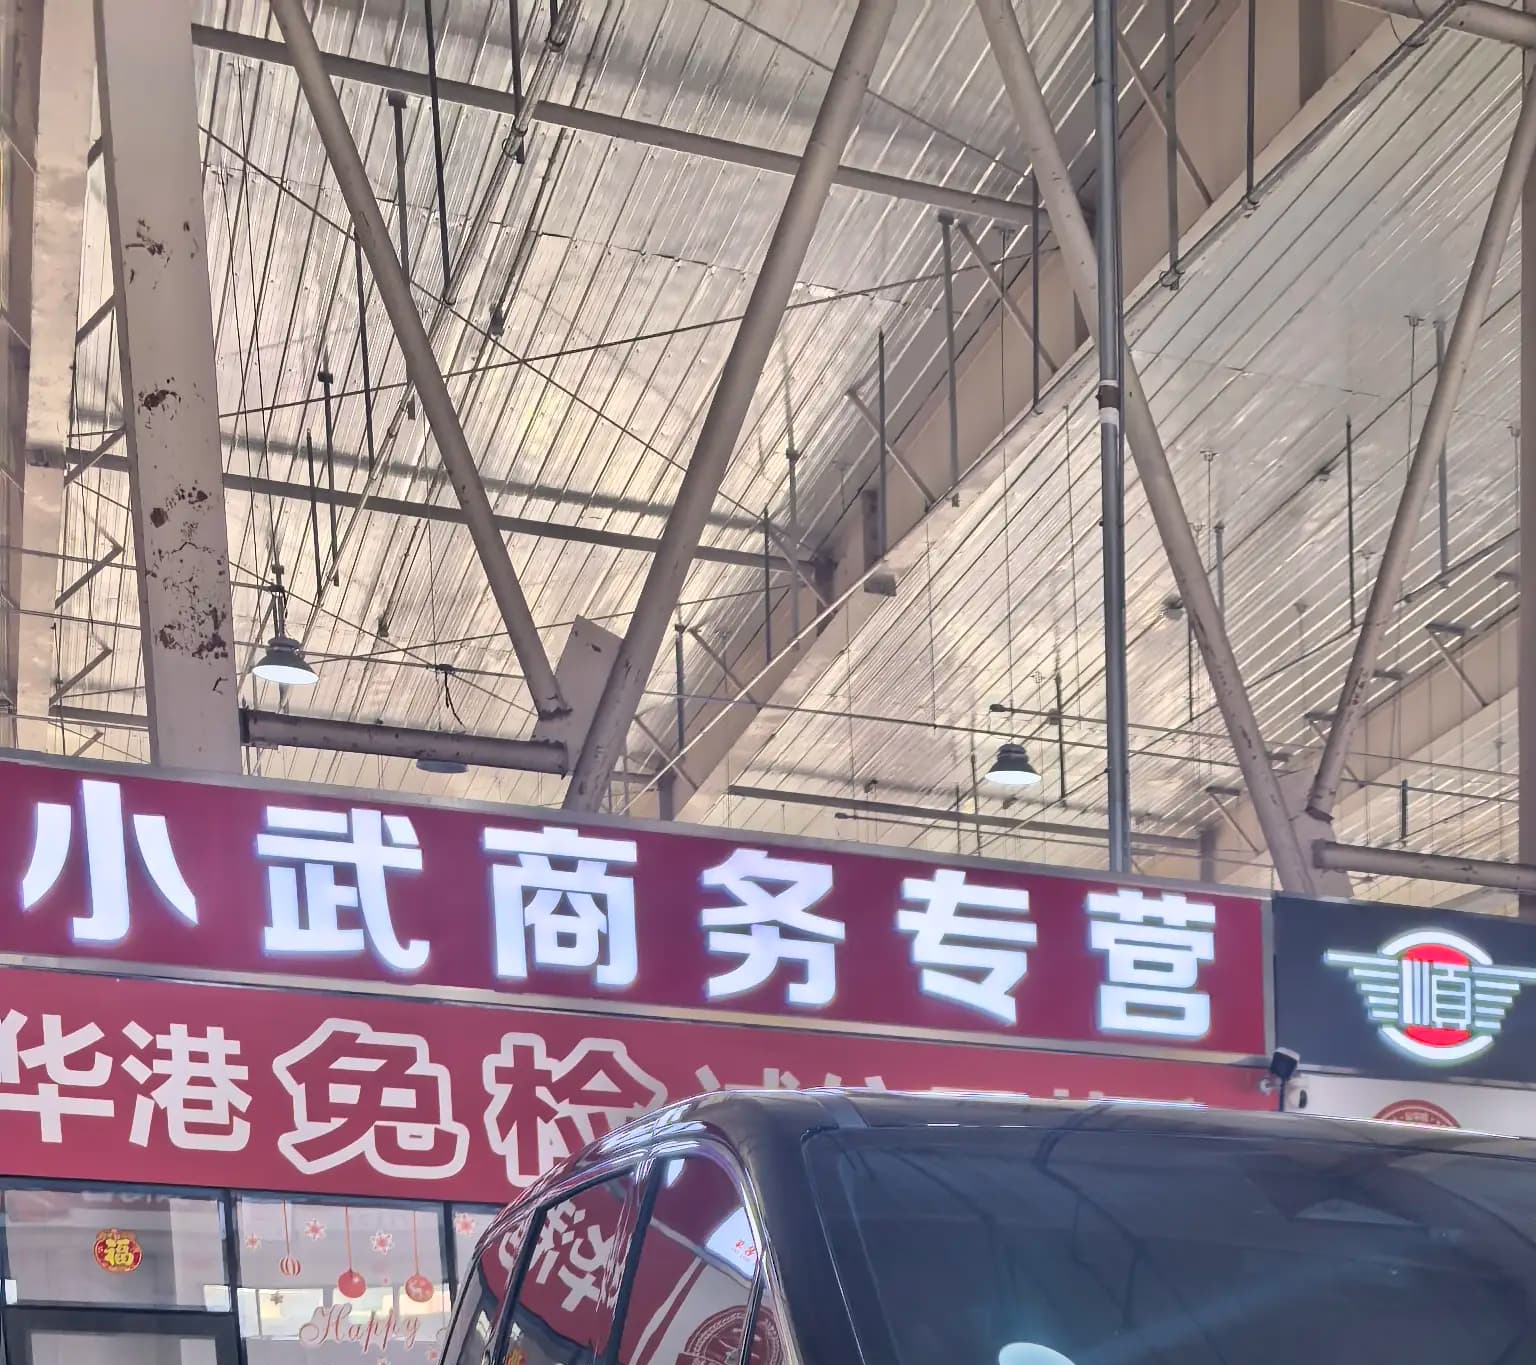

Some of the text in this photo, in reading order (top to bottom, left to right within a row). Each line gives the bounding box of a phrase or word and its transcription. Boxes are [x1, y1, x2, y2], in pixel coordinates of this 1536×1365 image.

[22, 779, 1216, 1038] 小武商务专营
[104, 1238, 135, 1267] 福
[299, 1302, 420, 1354] Happy
